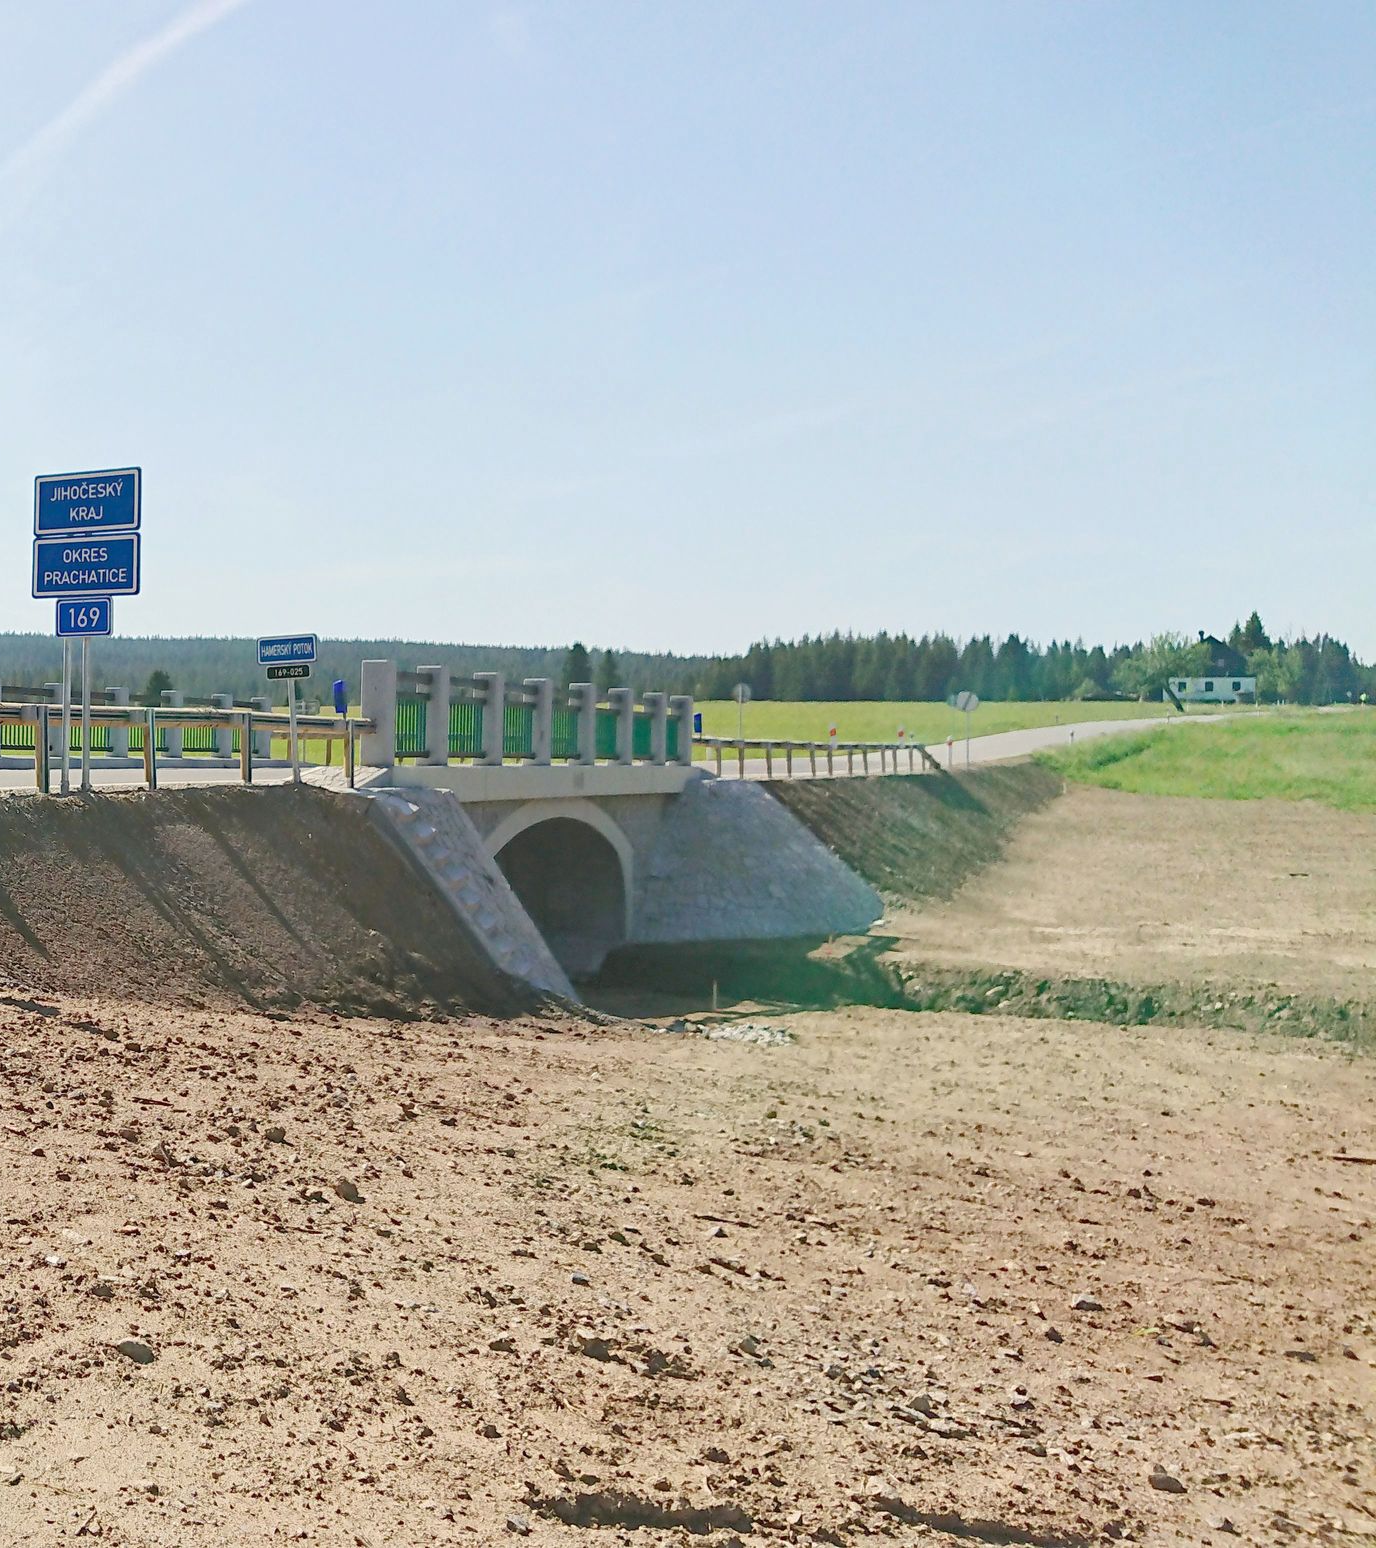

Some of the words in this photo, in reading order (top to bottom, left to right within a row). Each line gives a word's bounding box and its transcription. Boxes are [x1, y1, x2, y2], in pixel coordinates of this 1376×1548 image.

[50, 479, 124, 502] JIHOČESKÝ
[69, 505, 104, 522] KRAJ
[63, 547, 108, 563] OKRES
[44, 568, 127, 585] PRACHATICE
[69, 607, 100, 628] 169
[261, 641, 291, 657] HAMERSKÝ
[293, 642, 313, 655] POTOK
[274, 667, 303, 677] 169-025
